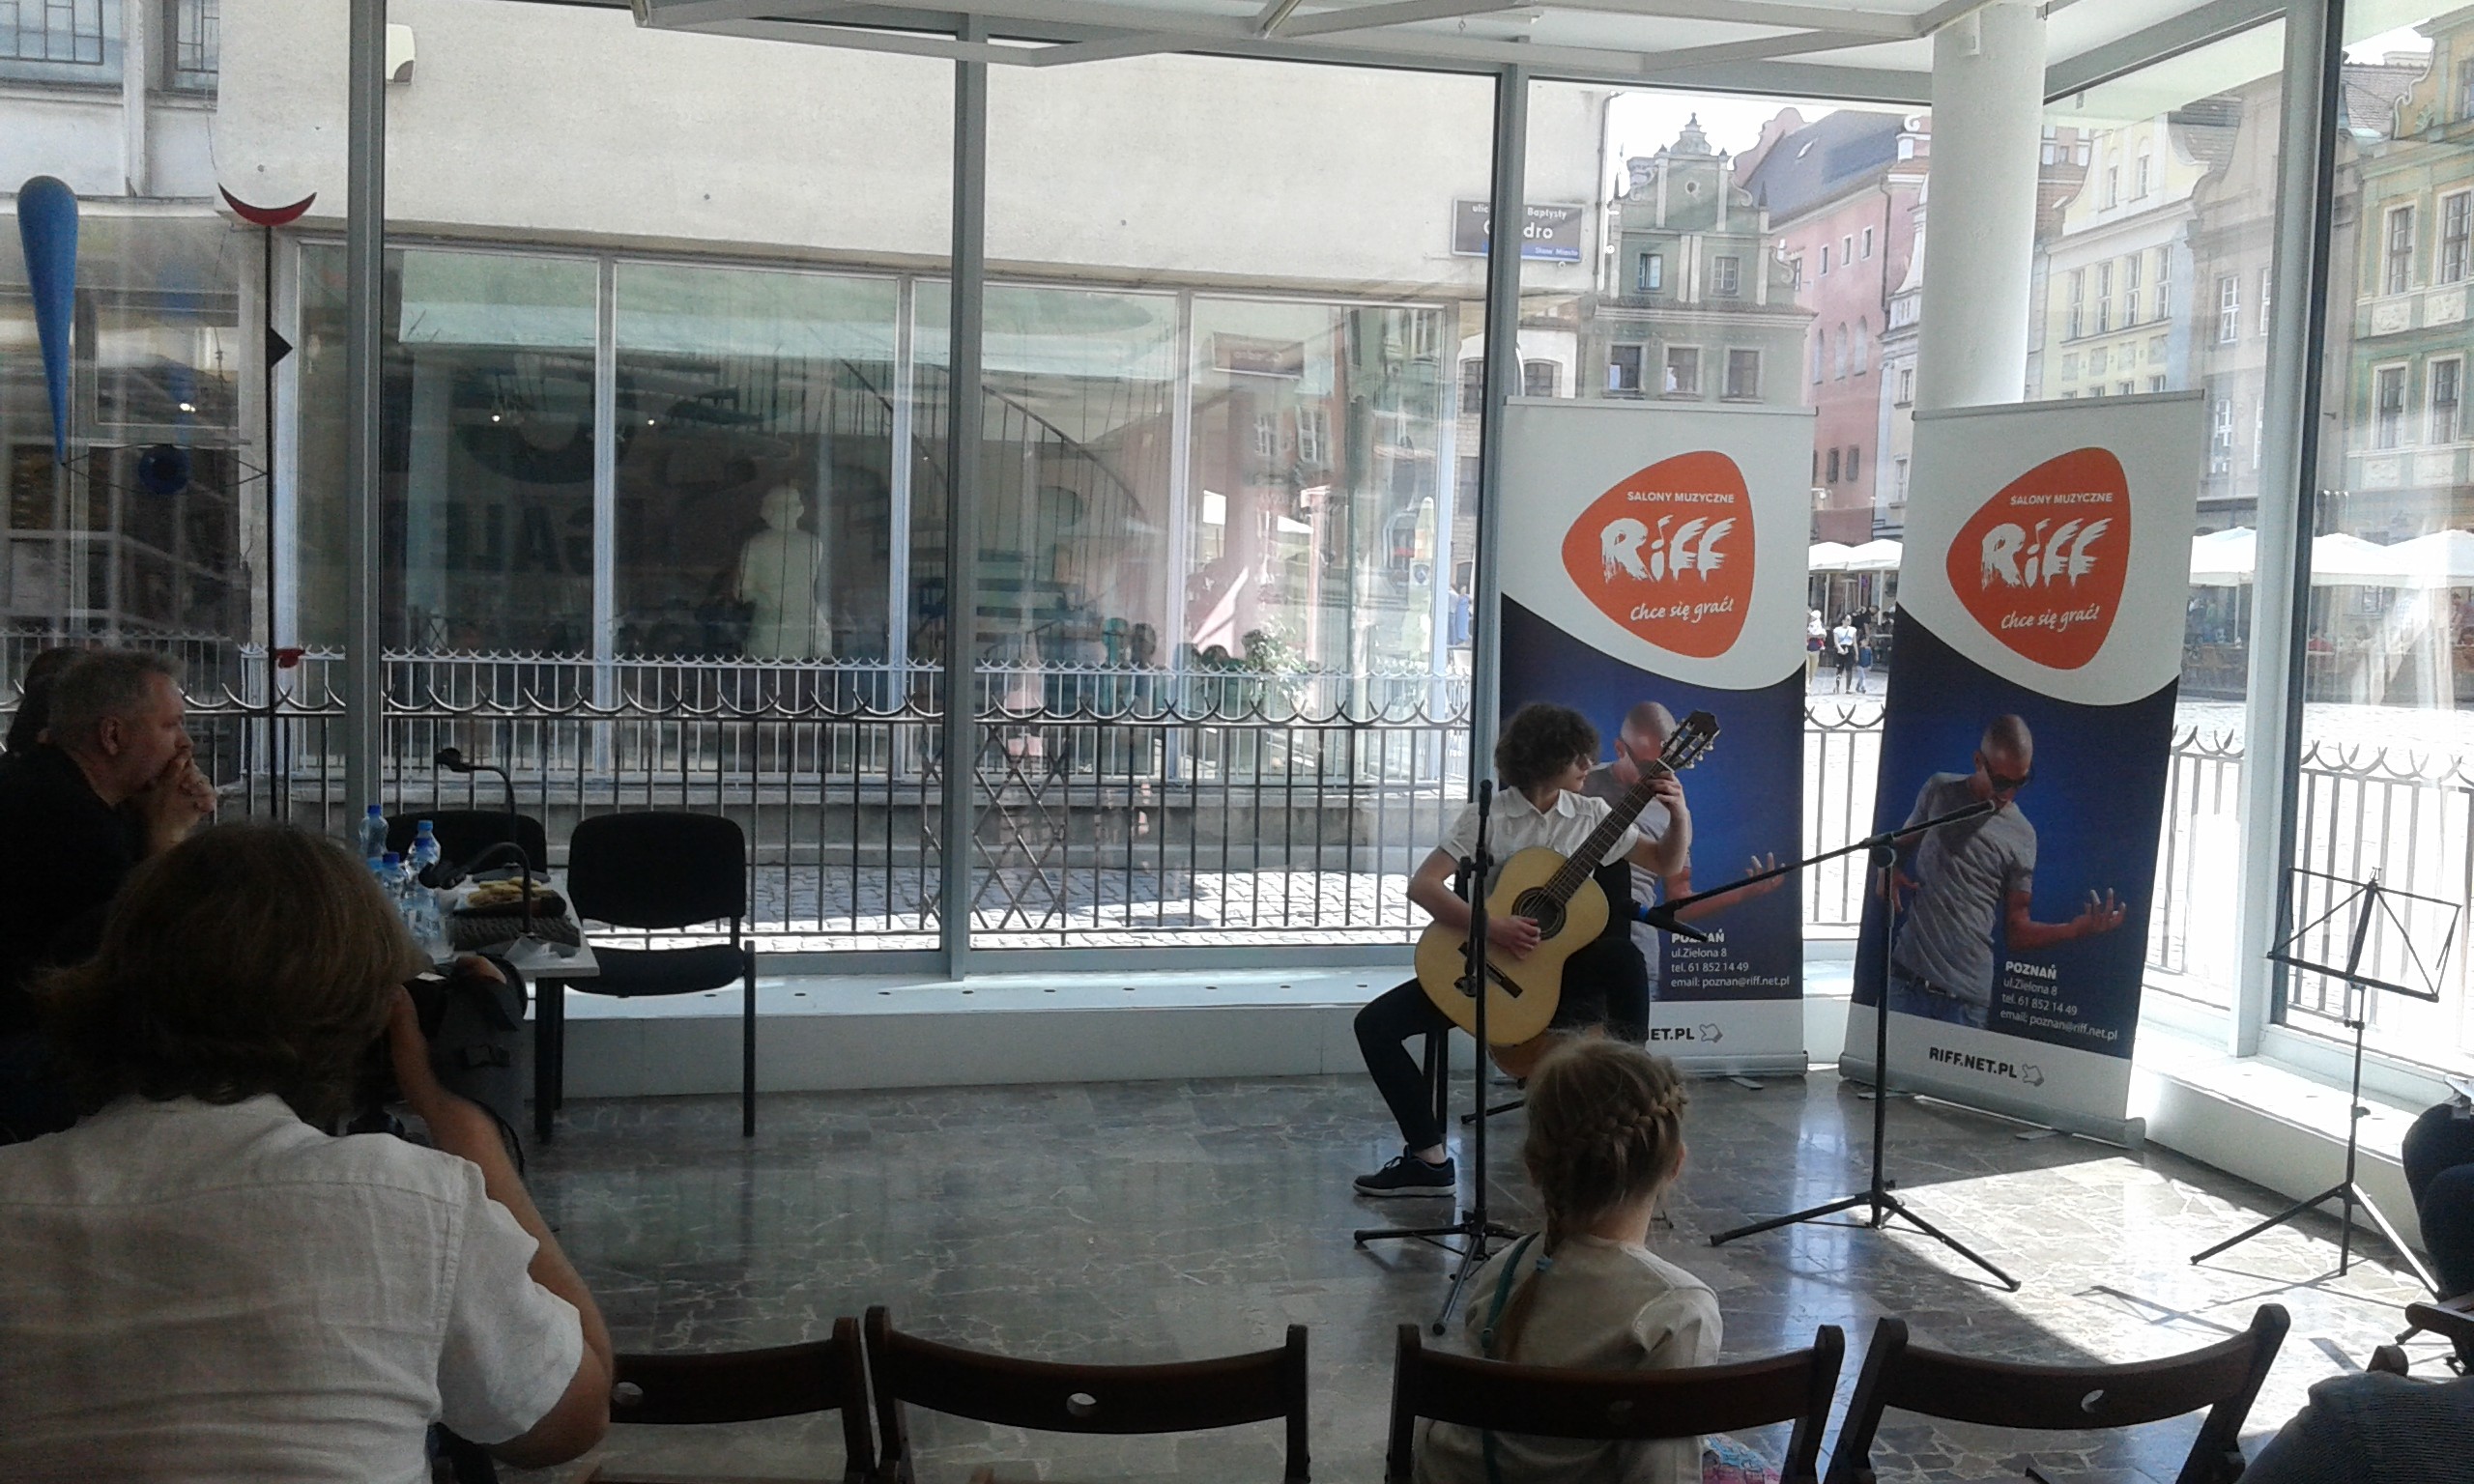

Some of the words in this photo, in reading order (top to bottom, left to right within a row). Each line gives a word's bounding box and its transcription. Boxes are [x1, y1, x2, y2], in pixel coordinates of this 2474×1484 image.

[1472, 203, 1489, 213] ulic
[1527, 207, 1567, 220] Baptysty
[1626, 491, 1672, 502] SALONY
[1674, 492, 1735, 503] MUZYCZNE
[2009, 494, 2053, 506] SALONY
[2054, 492, 2114, 505] MUZYCZNE
[1630, 603, 1665, 621] Chce
[1669, 601, 1690, 621] się
[1691, 595, 1734, 623] grać!
[2000, 611, 2034, 630] Chce
[2038, 608, 2057, 630] się
[2059, 603, 2101, 633] grać!
[1671, 948, 1719, 958] ul.Zielona
[1720, 948, 1728, 957] 8
[1671, 962, 1686, 973] tel.
[1687, 962, 1700, 972] 61
[1702, 962, 1720, 972] 852
[1724, 962, 1736, 972] 14
[1737, 961, 1749, 972] 49
[2005, 959, 2057, 980] POZNAŃ
[1671, 977, 1700, 988] email:
[1702, 975, 1790, 989] poznan@riff.net.pl
[2003, 977, 2050, 995] ul.Zielona
[2051, 985, 2058, 996] 8
[2001, 992, 2018, 1005] tel.
[2018, 995, 2029, 1007] 61
[2031, 997, 2050, 1012] 852
[2052, 1001, 2064, 1013] 14
[2064, 1004, 2078, 1015] 49
[1999, 1009, 2028, 1023] email:
[1929, 1046, 2018, 1079] RIFF.NET.PL
